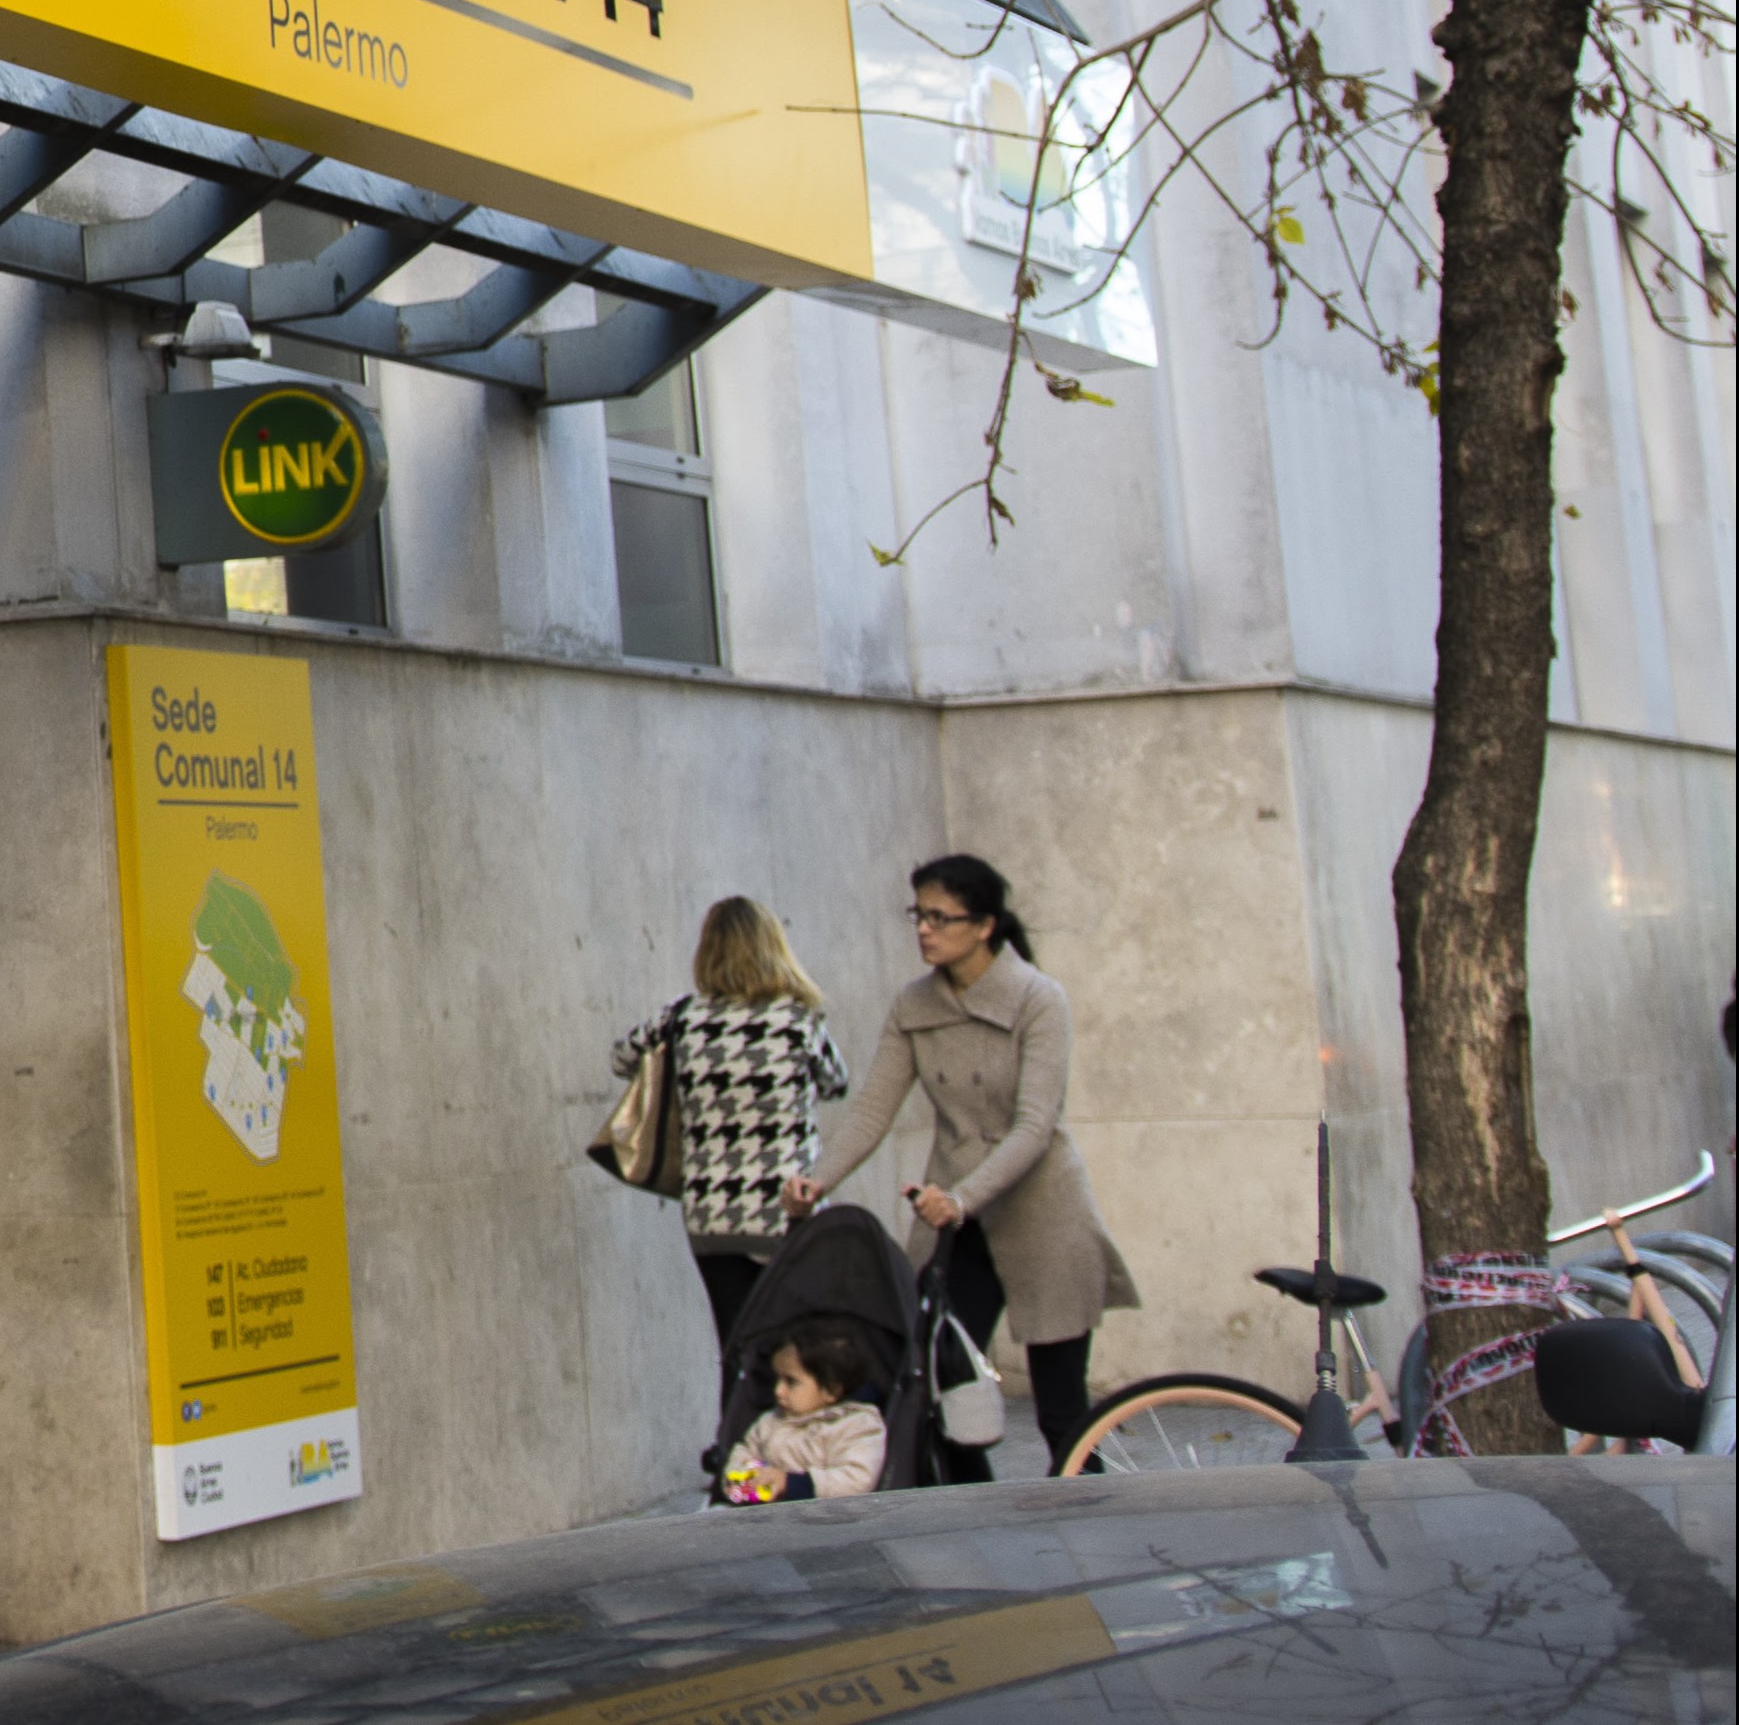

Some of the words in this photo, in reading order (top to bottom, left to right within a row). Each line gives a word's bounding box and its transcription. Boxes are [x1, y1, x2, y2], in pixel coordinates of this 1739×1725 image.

[231, 424, 352, 496] LINK
[151, 686, 217, 733] Sede
[155, 742, 265, 791] Comunal
[272, 748, 298, 792] 14
[206, 816, 259, 841] Palermo
